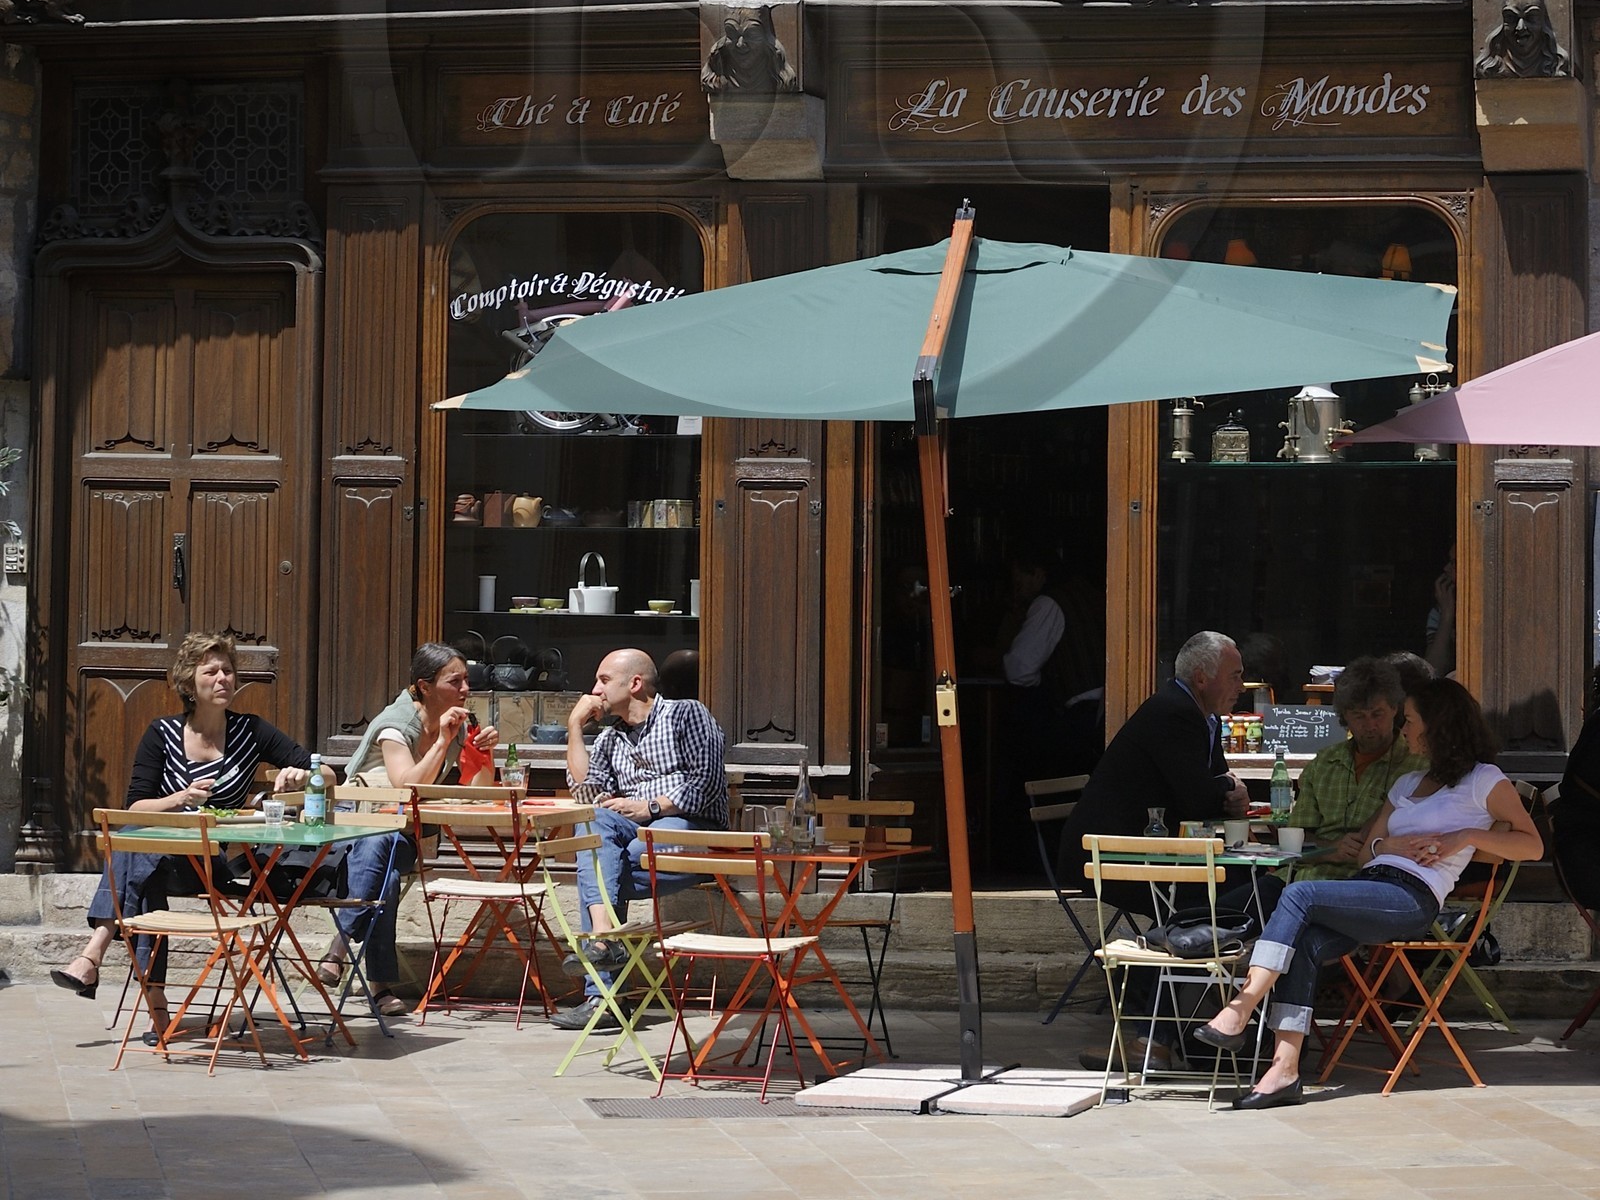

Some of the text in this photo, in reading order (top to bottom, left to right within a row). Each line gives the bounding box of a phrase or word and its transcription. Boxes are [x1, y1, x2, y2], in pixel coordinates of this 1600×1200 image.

[476, 92, 683, 132] Thé & Café
[888, 72, 1431, 134] La Causerie des Mondes
[450, 273, 549, 320] Comptoir
[550, 273, 569, 294] &
